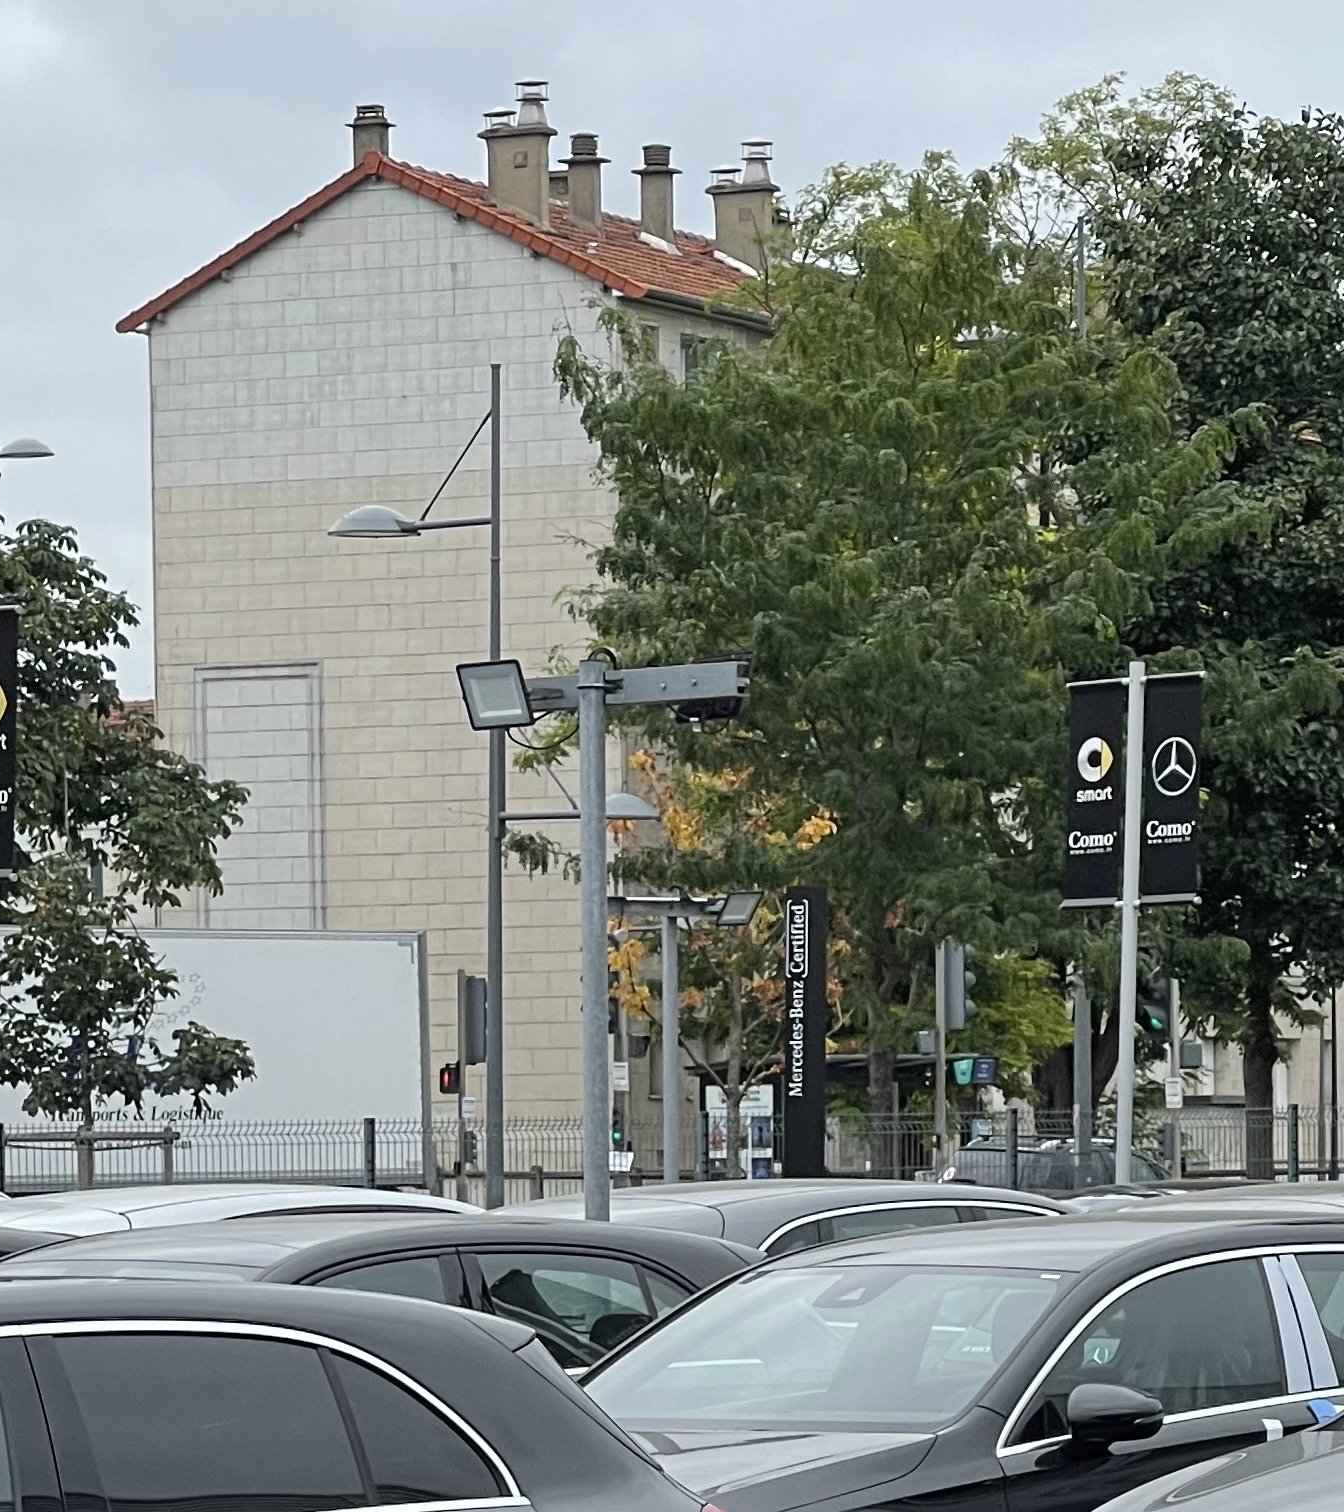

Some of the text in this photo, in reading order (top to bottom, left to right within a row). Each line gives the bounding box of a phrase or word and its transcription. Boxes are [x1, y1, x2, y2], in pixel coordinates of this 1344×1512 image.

[1076, 786, 1113, 803] smart
[1146, 820, 1193, 838] Como
[1068, 831, 1114, 849] Como
[788, 904, 805, 1097] Mercedes-Benz Certified
